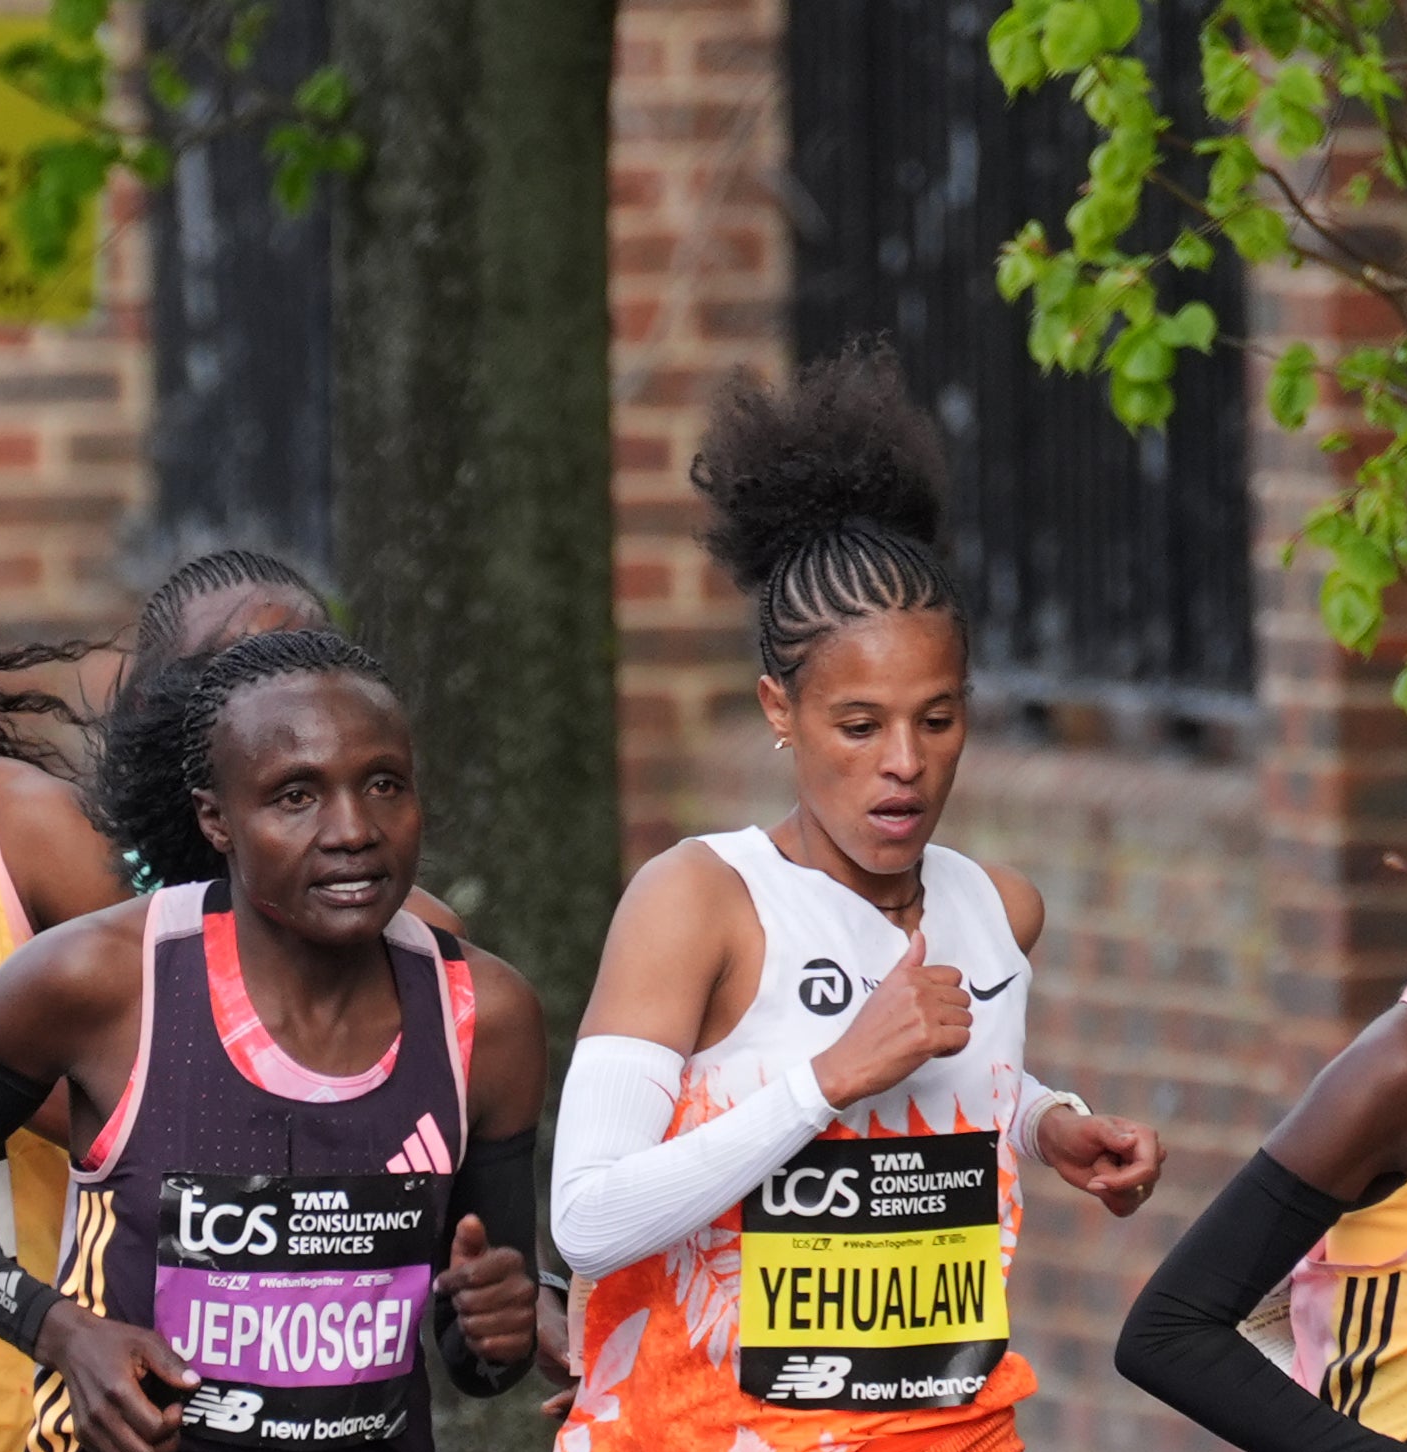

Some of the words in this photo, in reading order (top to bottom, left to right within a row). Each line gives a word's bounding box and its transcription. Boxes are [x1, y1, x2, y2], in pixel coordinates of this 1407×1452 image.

[870, 1153, 925, 1172] TATA
[761, 1167, 861, 1218] tcs
[870, 1169, 985, 1195] CONSULTANCY
[292, 1191, 349, 1210] TATA
[870, 1195, 947, 1218] SERVICES
[178, 1184, 278, 1256] tcs
[288, 1209, 422, 1233] CONSULTANCY
[288, 1235, 374, 1255] SERVICES
[259, 1275, 344, 1288] #WeRunTogether
[759, 1260, 986, 1332] YEHUALAW
[171, 1299, 413, 1373] JEPKOSGEI
[851, 1382, 898, 1400] new
[261, 1419, 311, 1440] new
[314, 1413, 386, 1440] balance
